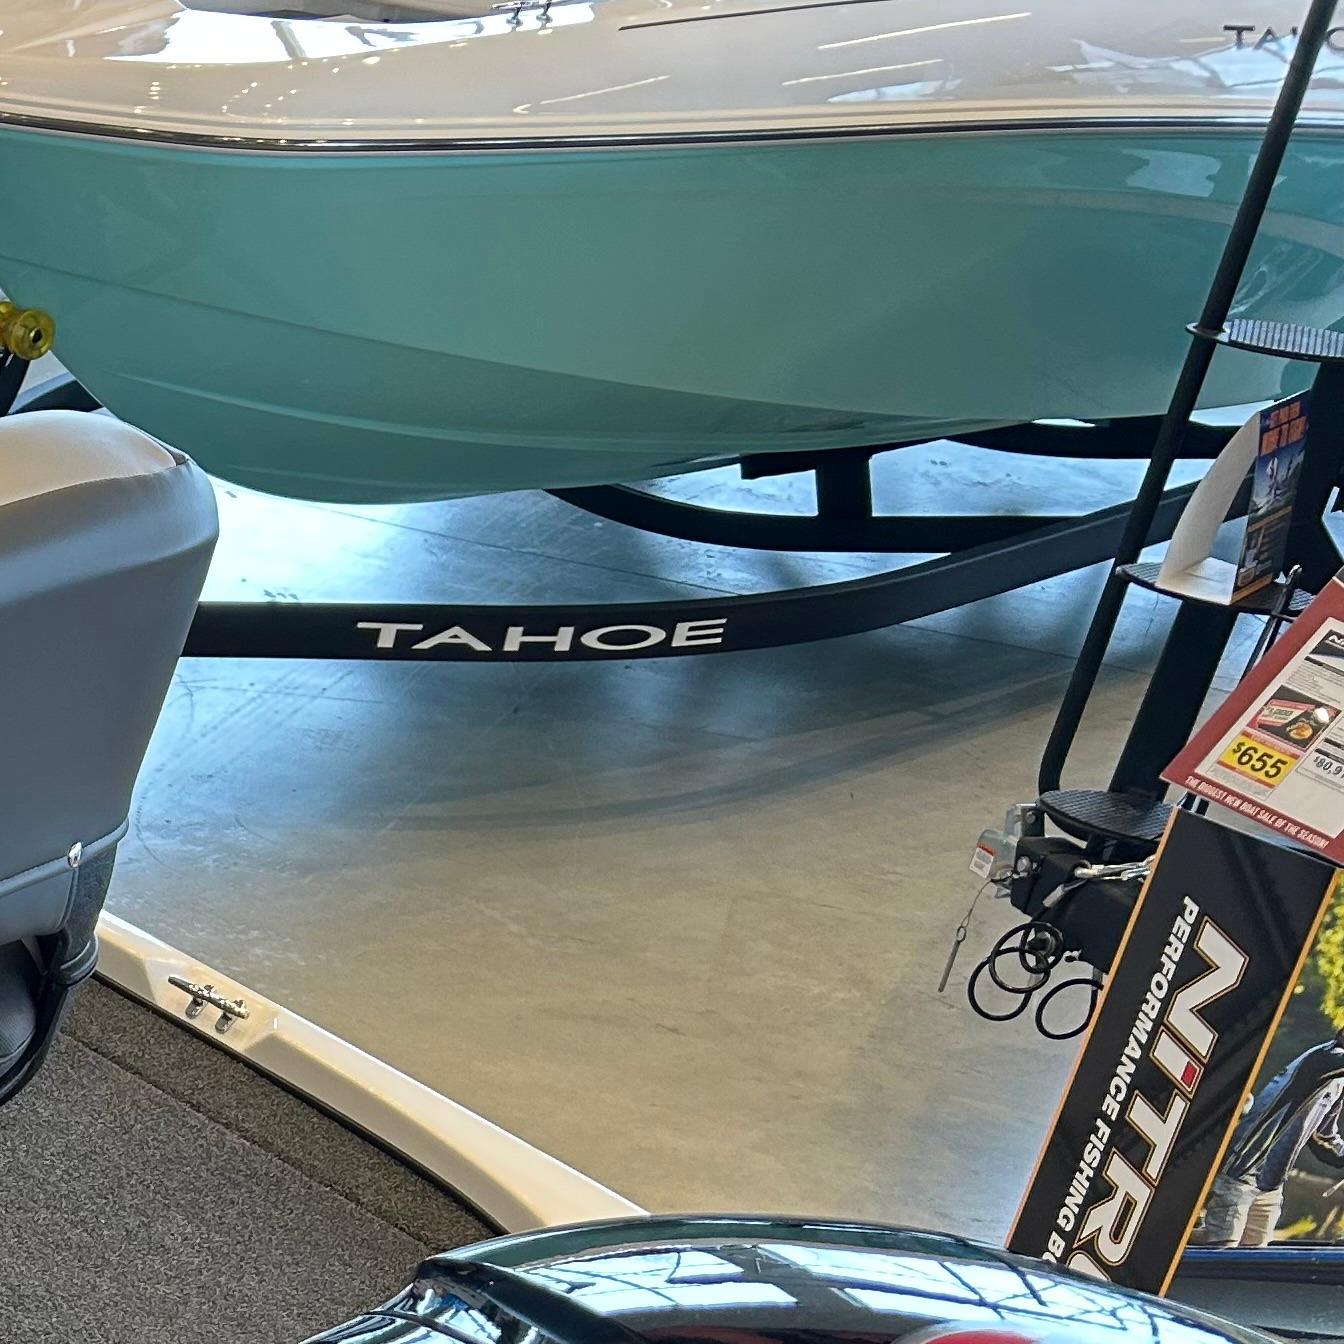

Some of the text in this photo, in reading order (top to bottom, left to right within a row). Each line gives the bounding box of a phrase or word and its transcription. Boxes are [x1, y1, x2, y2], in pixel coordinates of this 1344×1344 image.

[356, 618, 728, 652] TAHOE
[1233, 741, 1289, 779] $655
[1257, 809, 1275, 823] SALE
[1284, 822, 1298, 834] THE
[1101, 895, 1201, 1122] PERFORMANCE
[1055, 1117, 1112, 1234] FISHING
